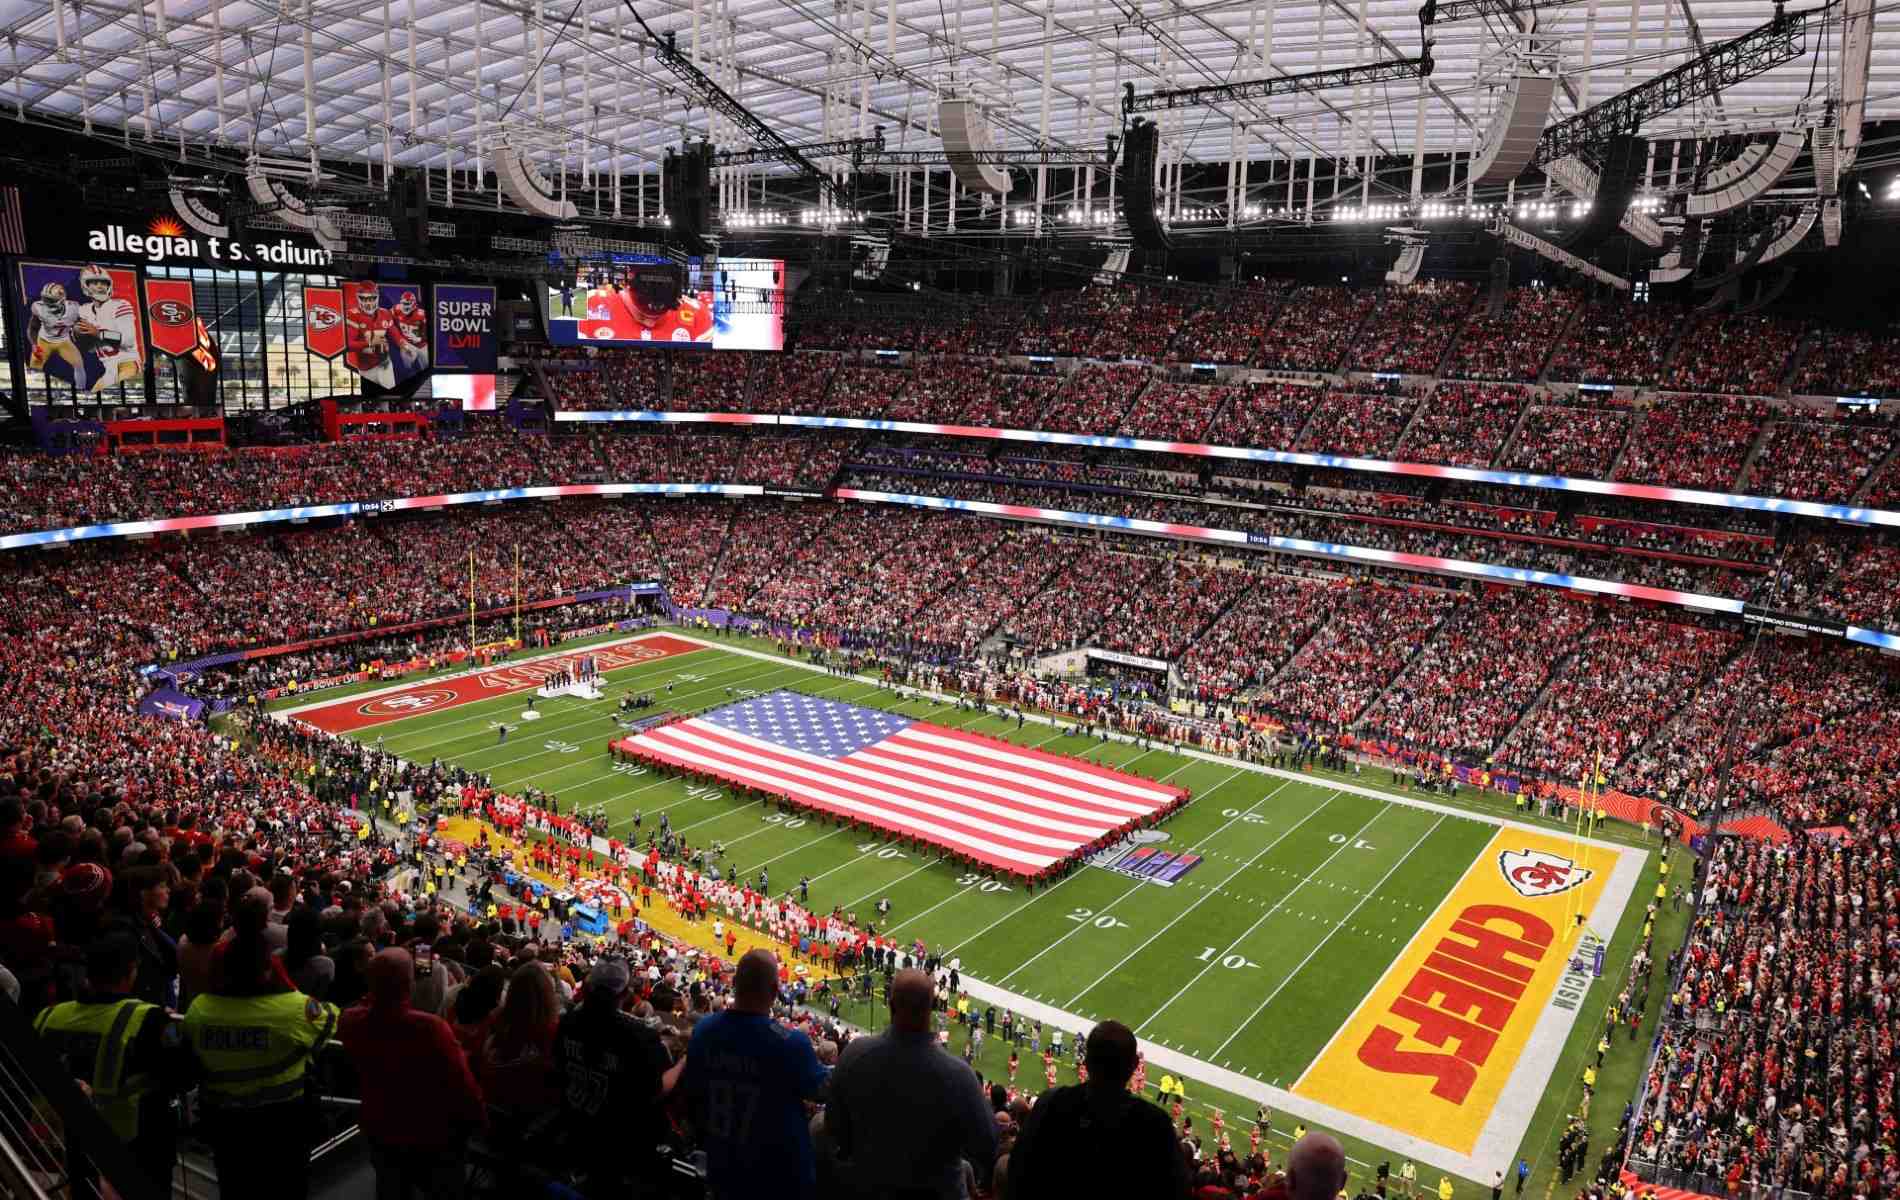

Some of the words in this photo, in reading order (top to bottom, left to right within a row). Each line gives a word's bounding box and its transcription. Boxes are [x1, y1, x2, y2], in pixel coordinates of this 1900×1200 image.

[229, 239, 333, 266] sadium
[439, 301, 491, 316] SUPER
[441, 318, 490, 332] BOWL
[448, 336, 481, 349] LVIII
[956, 873, 1002, 892] 30
[1066, 908, 1116, 928] 20
[1194, 946, 1246, 968] 10
[1357, 904, 1554, 1105] CHIEFS
[205, 1027, 267, 1049] POLICE
